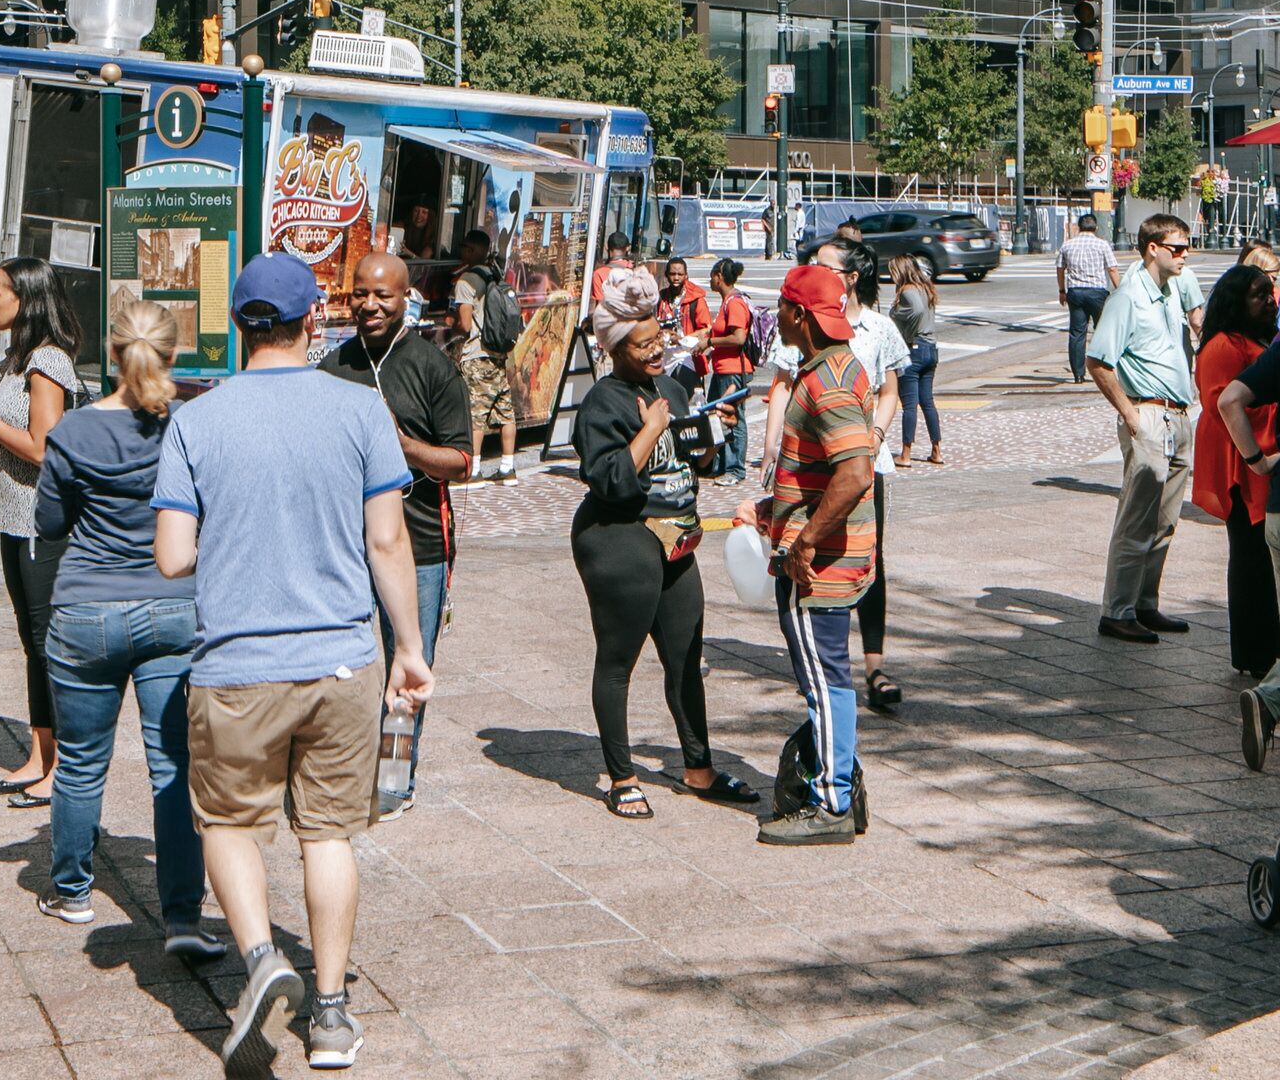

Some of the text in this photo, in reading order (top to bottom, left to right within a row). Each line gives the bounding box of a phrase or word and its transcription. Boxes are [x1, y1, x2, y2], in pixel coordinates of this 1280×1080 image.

[1116, 78, 1188, 89] Auburn Ave NE
[133, 163, 225, 182] DOWNTOWN
[273, 133, 323, 197] Big
[112, 192, 233, 208] Atlanta's Main Streets
[271, 201, 341, 229] CHICAGO KITCHEN
